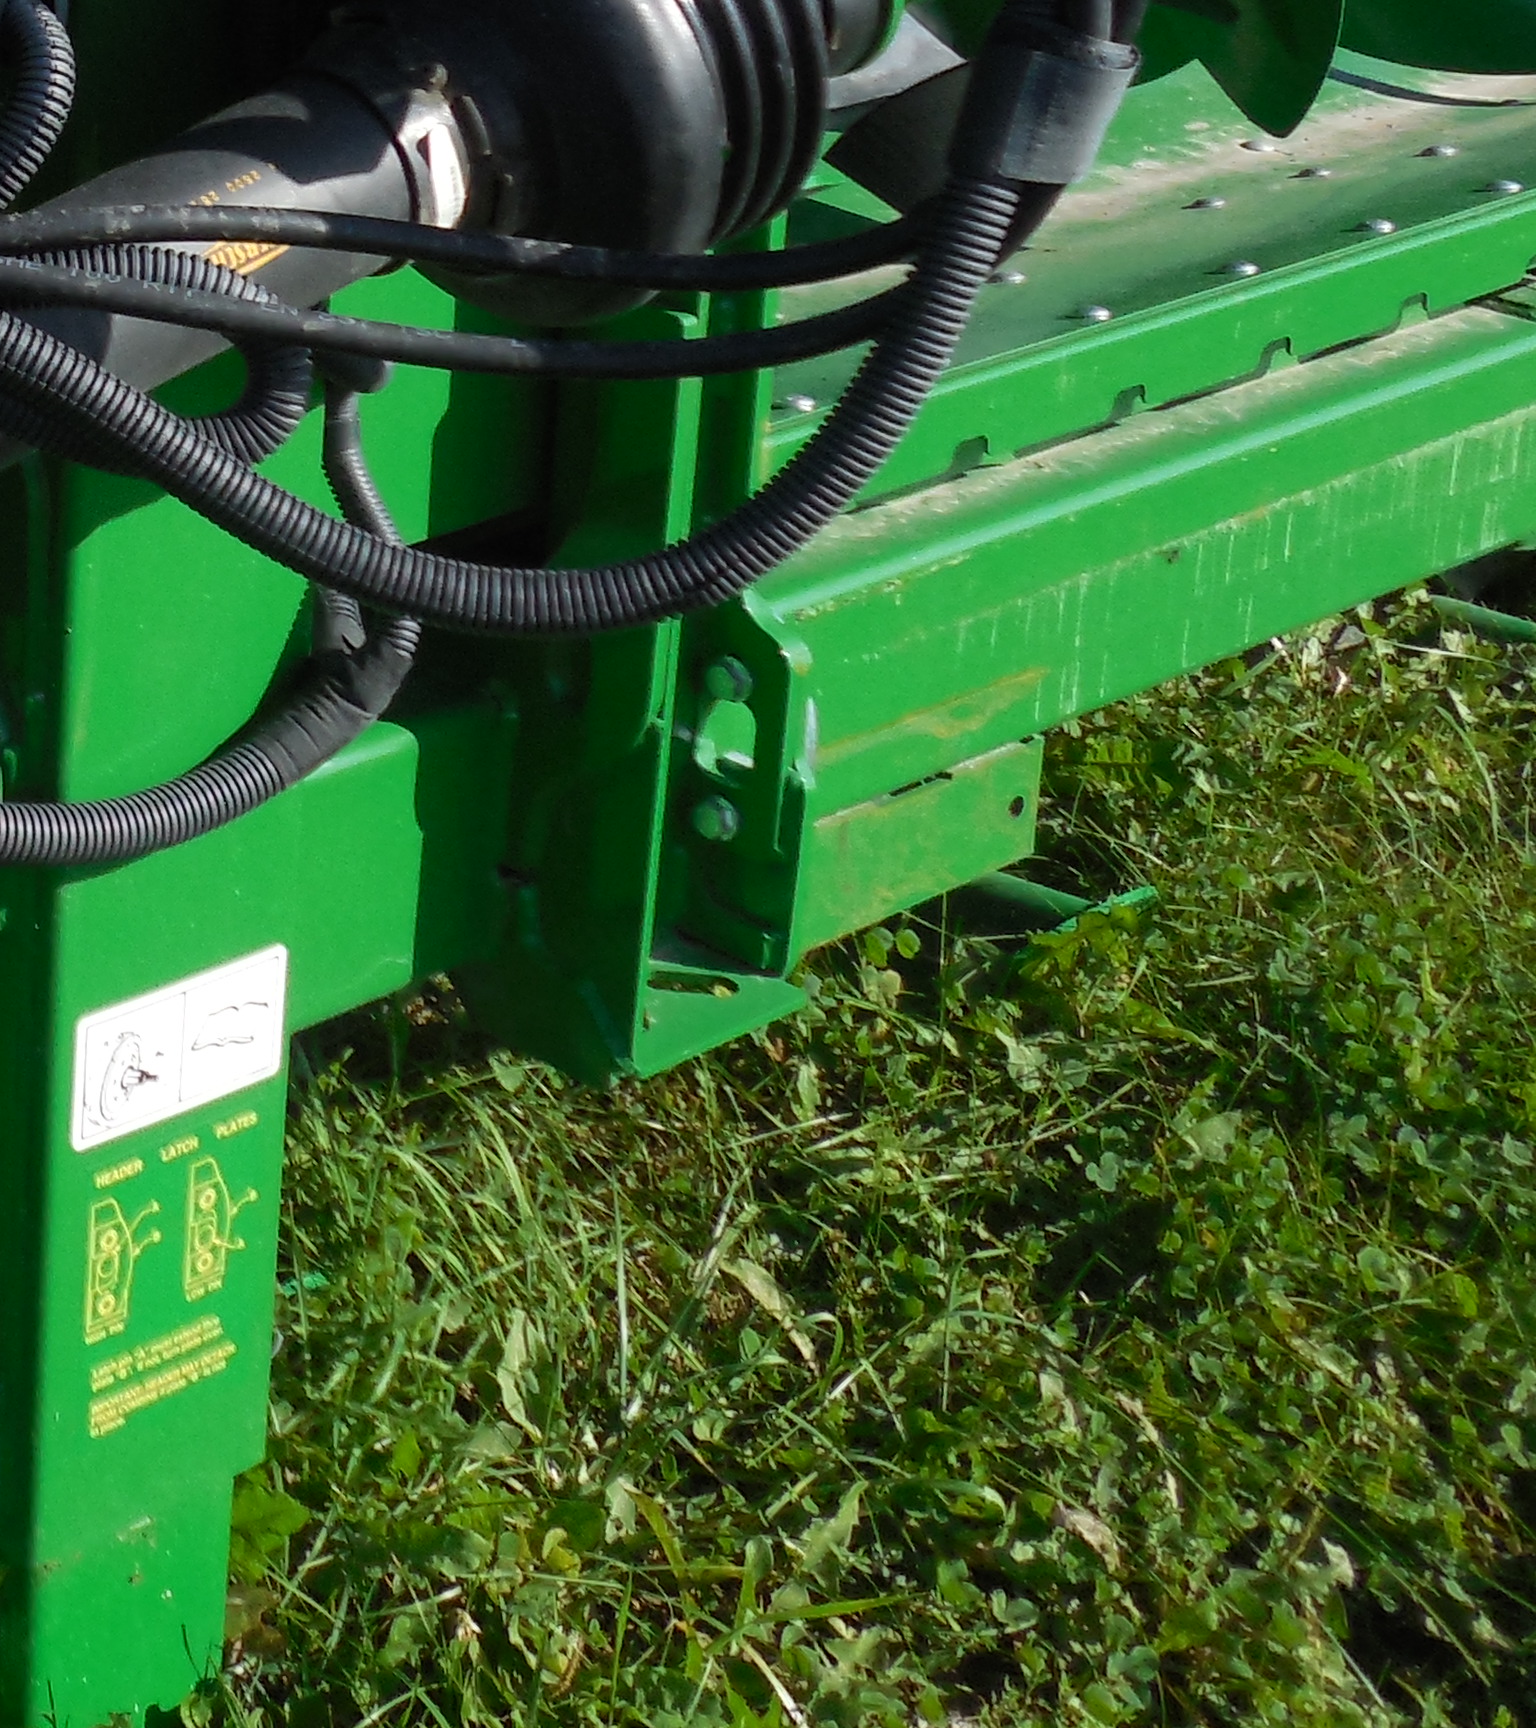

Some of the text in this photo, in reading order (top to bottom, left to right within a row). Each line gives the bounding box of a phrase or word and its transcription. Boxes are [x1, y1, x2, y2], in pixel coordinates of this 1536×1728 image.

[93, 1108, 259, 1190] HEADER LATCH PLATES
